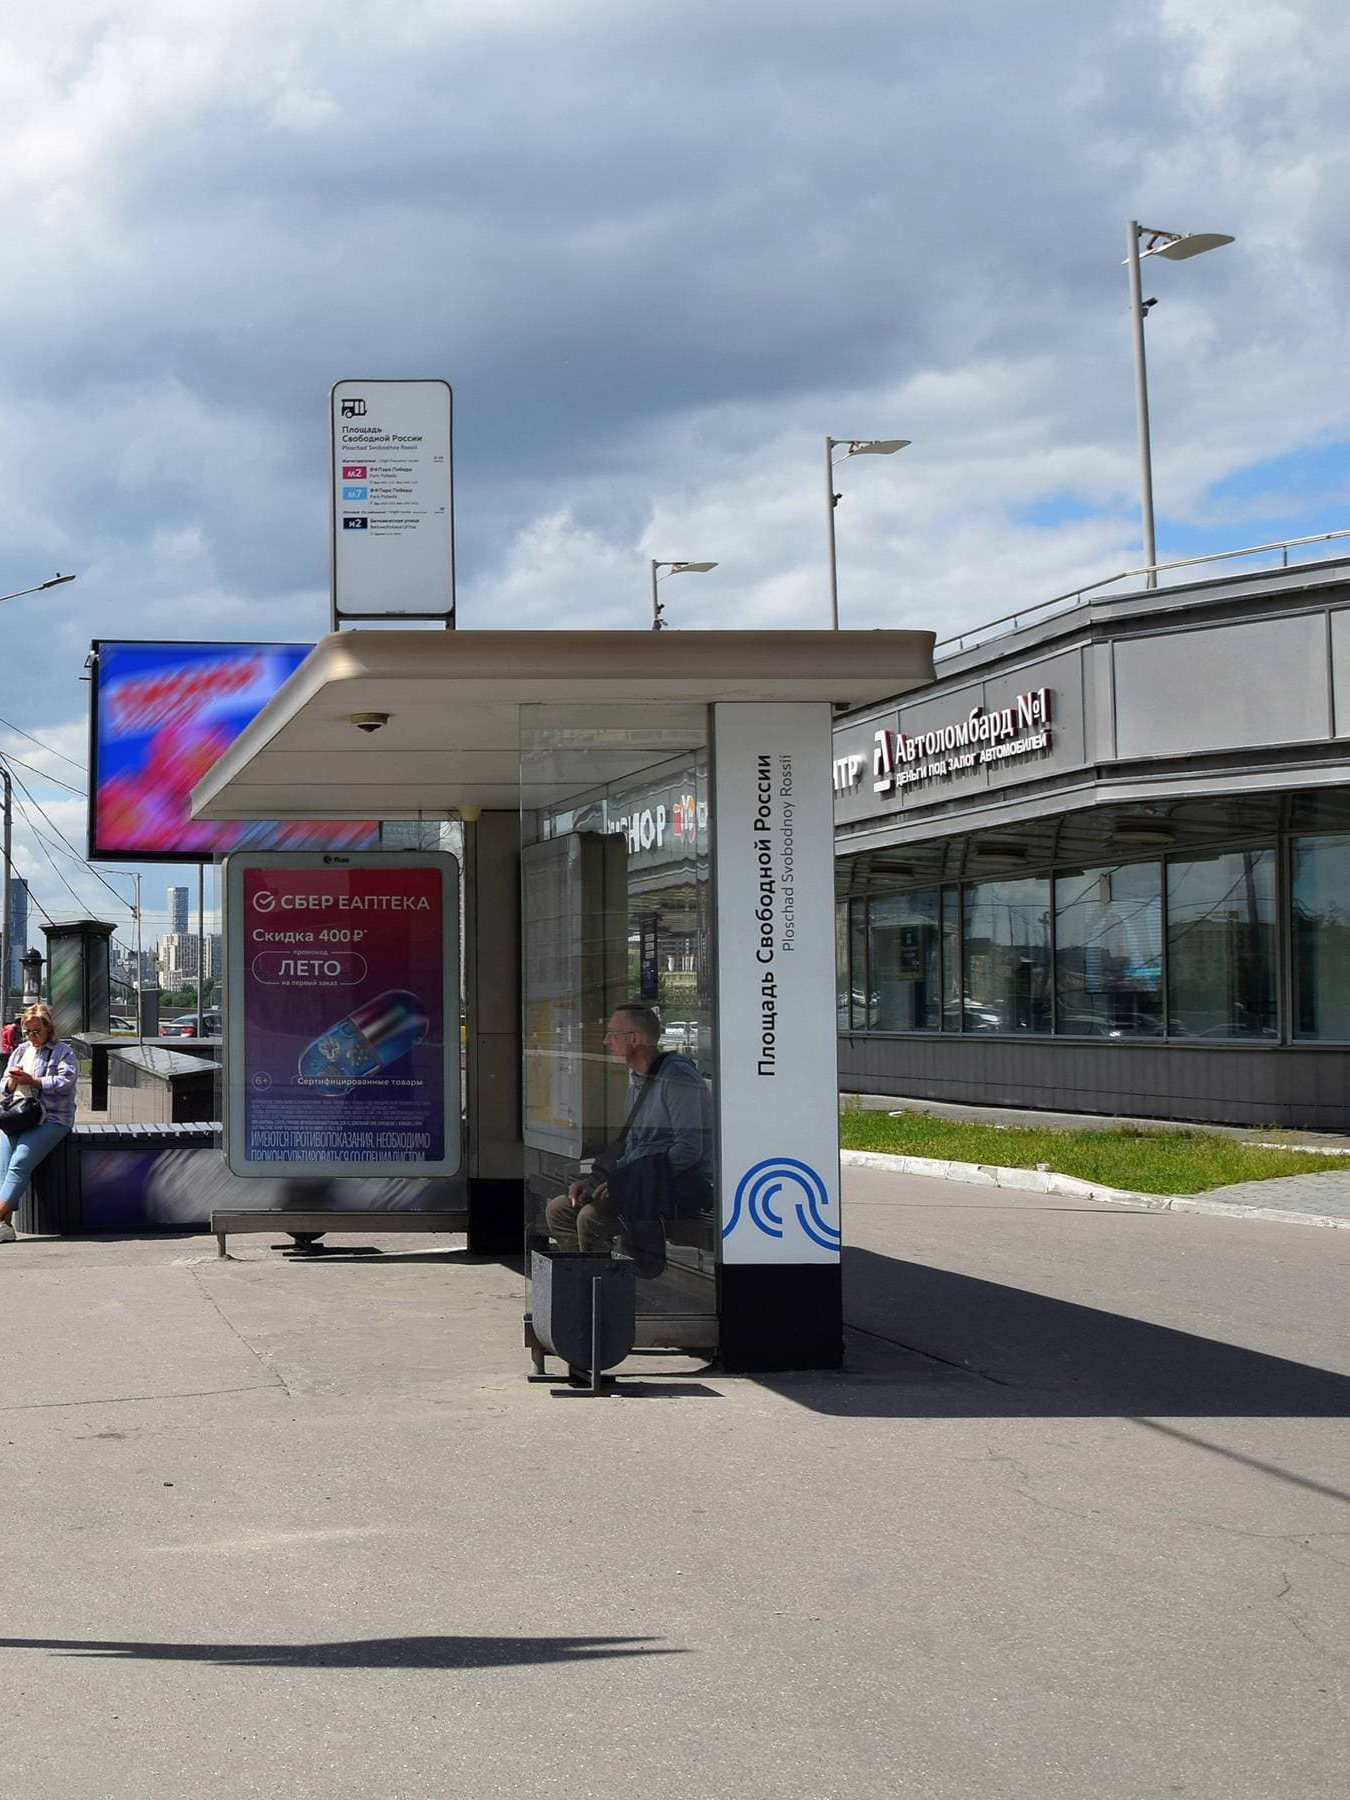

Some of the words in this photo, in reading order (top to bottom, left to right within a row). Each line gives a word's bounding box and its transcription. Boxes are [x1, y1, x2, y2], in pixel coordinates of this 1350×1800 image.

[342, 426, 383, 434] Площадь
[342, 435, 390, 443] Свободной
[895, 706, 1015, 765] Автоломбард
[1017, 688, 1050, 729] №1
[896, 766, 928, 788] ДЕНЬГИ
[928, 761, 947, 779] ПОД
[948, 752, 977, 772] ЗАЛОГ
[979, 729, 1048, 764] АВТОМОБИЛЕЙ
[779, 754, 793, 797] Rossii
[754, 754, 772, 833] России
[780, 802, 797, 884] Svobodnoy
[281, 895, 334, 909] СБЕР
[338, 896, 431, 910] ЕАПТЕКА
[755, 838, 777, 964] Свободной
[781, 888, 796, 953] Ploschad
[252, 929, 314, 943] Скидка
[278, 960, 341, 976] ЛЕТО
[292, 979, 318, 987] первый
[757, 972, 778, 1076] Площадь
[254, 1076, 269, 1085] 6+
[297, 1077, 390, 1087] Сертифицированные
[391, 1078, 423, 1087] товары
[251, 1131, 289, 1147] ИМЕЮТСЯ
[376, 1132, 430, 1151] НЕОБХОДИМО
